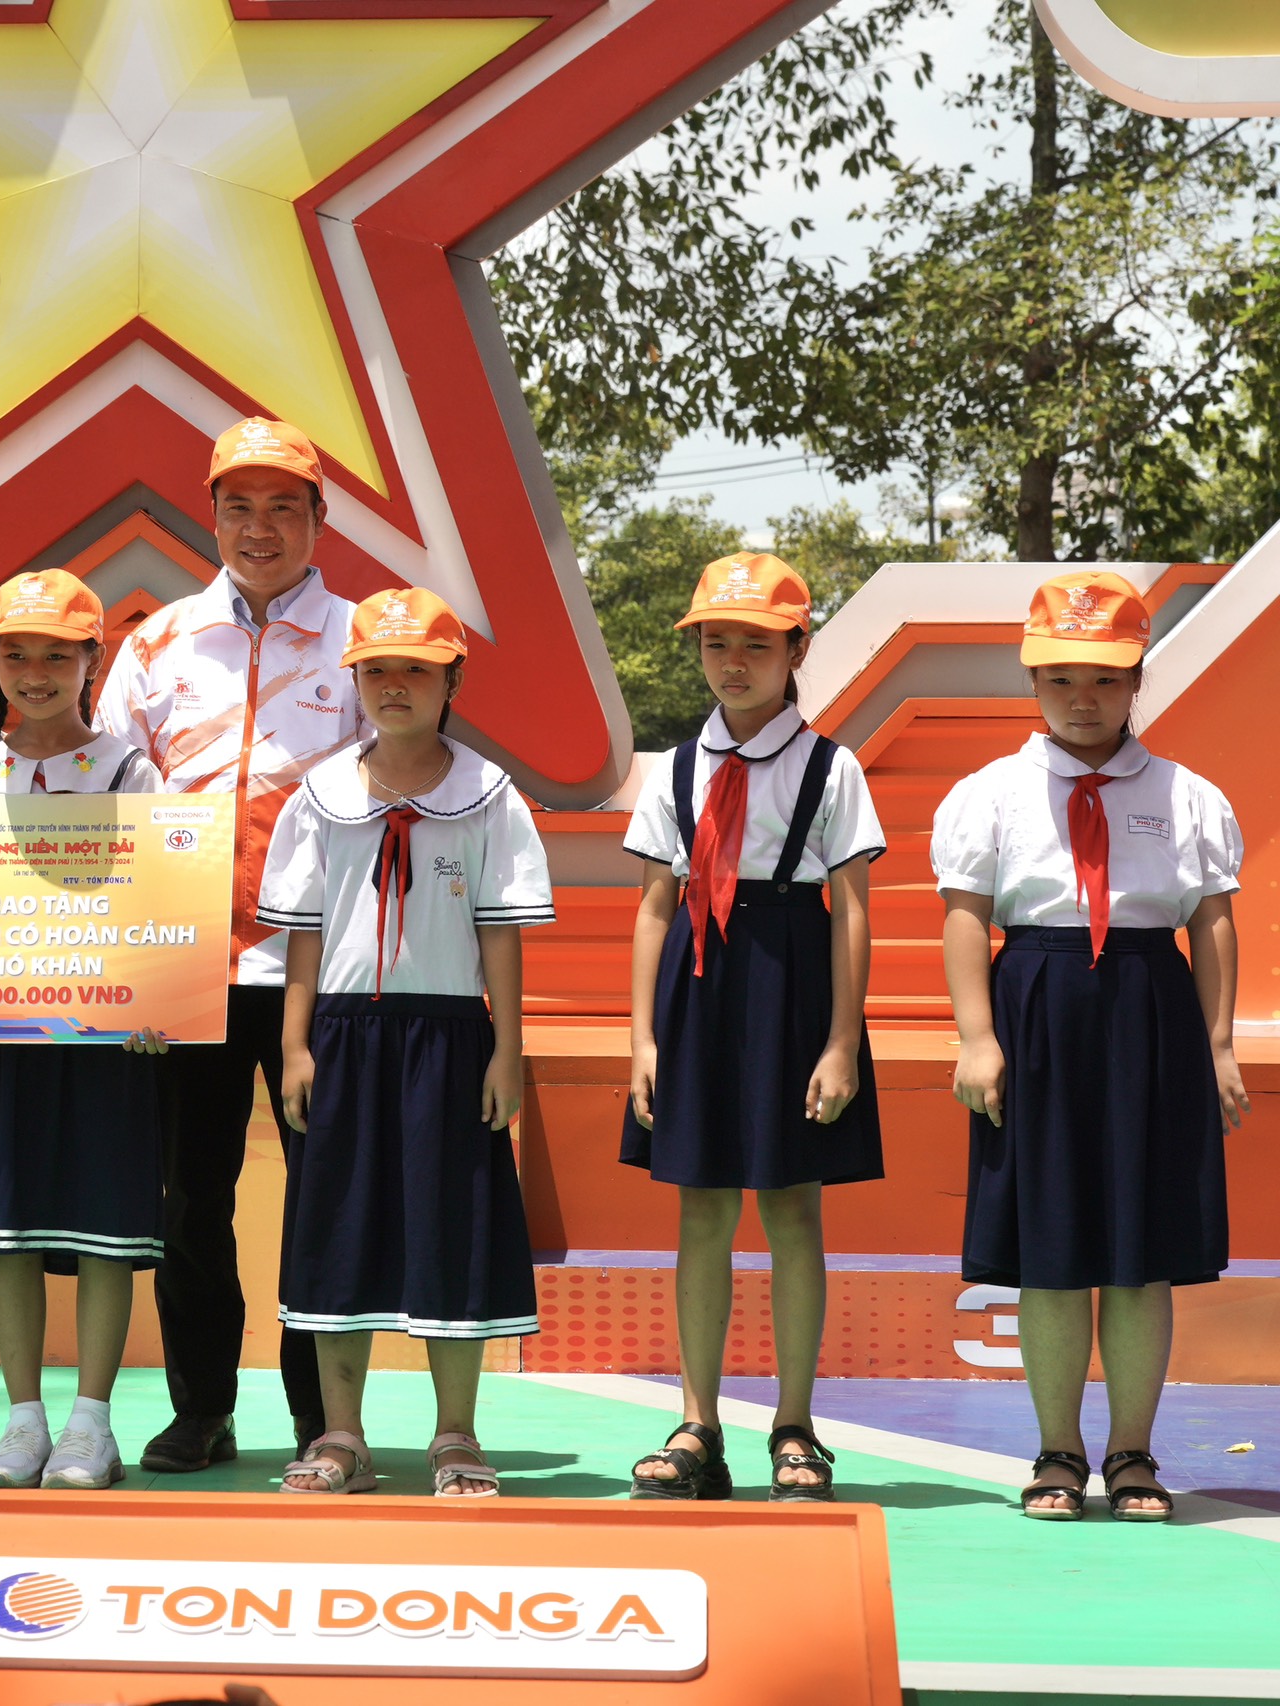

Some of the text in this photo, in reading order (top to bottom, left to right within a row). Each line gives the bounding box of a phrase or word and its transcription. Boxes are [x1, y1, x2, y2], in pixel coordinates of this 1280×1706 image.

[296, 700, 313, 709] TON
[315, 704, 337, 713] DONG
[122, 824, 135, 832] MINH
[64, 839, 102, 856] MỘT
[42, 891, 109, 920] TẶNG
[5, 922, 39, 946] CÓ
[46, 922, 119, 945] HOÀN
[124, 919, 195, 945] CẢNH
[31, 952, 103, 976] KHĂN
[78, 986, 133, 1004] VNĐ
[106, 1585, 670, 1638] TON DONG A
